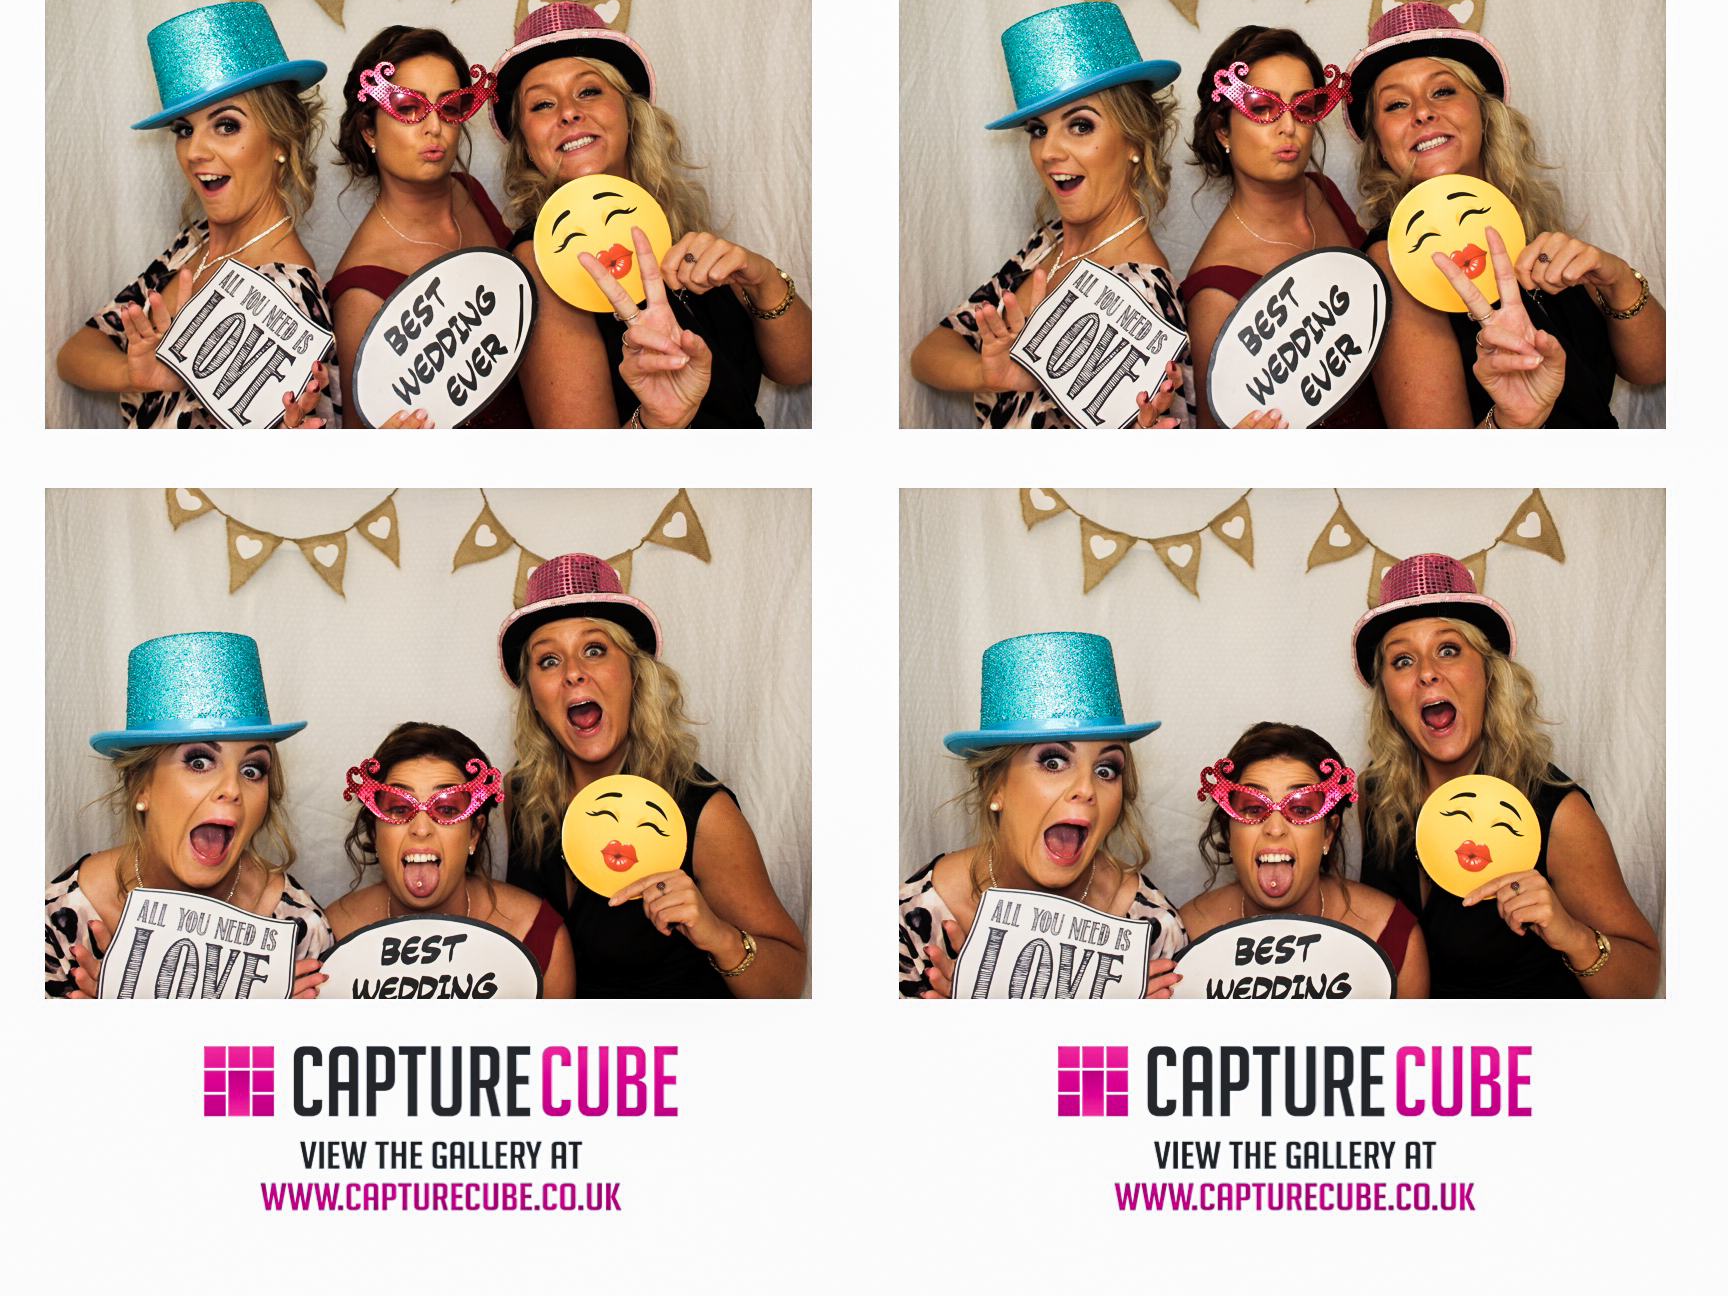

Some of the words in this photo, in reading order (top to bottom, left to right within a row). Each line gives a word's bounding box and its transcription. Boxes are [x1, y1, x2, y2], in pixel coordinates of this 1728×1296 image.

[219, 270, 245, 297] ALL
[240, 285, 270, 316] YOU
[262, 305, 298, 340] NEED
[292, 330, 314, 354] IS
[384, 277, 445, 356] BEST
[392, 285, 496, 405] WEDDING
[1073, 270, 1099, 297] ALL
[1094, 285, 1124, 316] YOU
[1116, 305, 1152, 340] NEED
[1146, 330, 1168, 354] IS
[1238, 277, 1299, 356] BEST
[1246, 285, 1350, 405] WEDDING
[168, 290, 296, 426] LOVE
[447, 334, 508, 406] EVER
[1022, 290, 1150, 426] LOVE
[1301, 334, 1362, 406] EVER
[137, 899, 168, 927] ALL
[177, 907, 211, 936] YOU
[214, 917, 256, 945] NEED
[261, 927, 278, 951] IS
[381, 934, 467, 966] BEST
[991, 899, 1022, 927] ALL
[1031, 907, 1065, 936] YOU
[1068, 917, 1110, 945] NEED
[1115, 927, 1132, 951] IS
[1235, 934, 1321, 966] BEST
[352, 972, 498, 999] WEDDING
[1206, 972, 1352, 999] WEDDING
